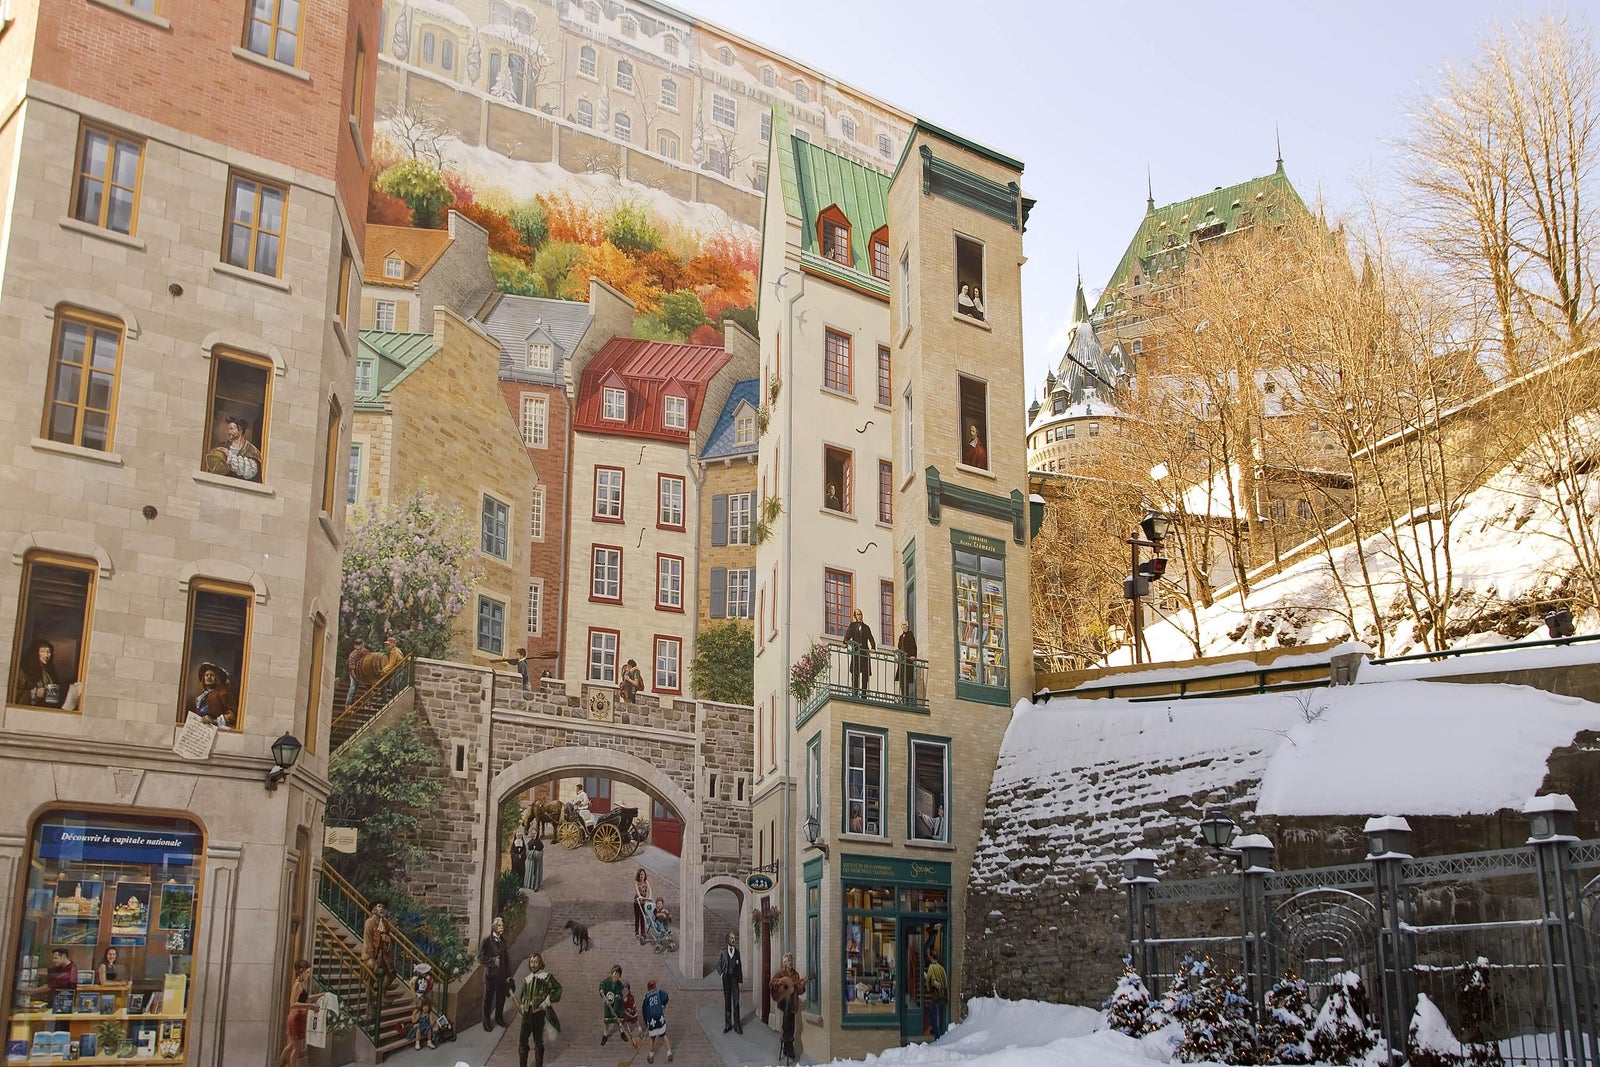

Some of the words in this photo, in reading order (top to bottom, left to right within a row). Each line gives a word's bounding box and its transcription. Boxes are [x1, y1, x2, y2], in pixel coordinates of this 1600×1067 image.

[61, 832, 101, 842] Découvrir
[102, 835, 110, 843] la
[113, 836, 145, 845] capitale
[146, 839, 182, 847] nationale
